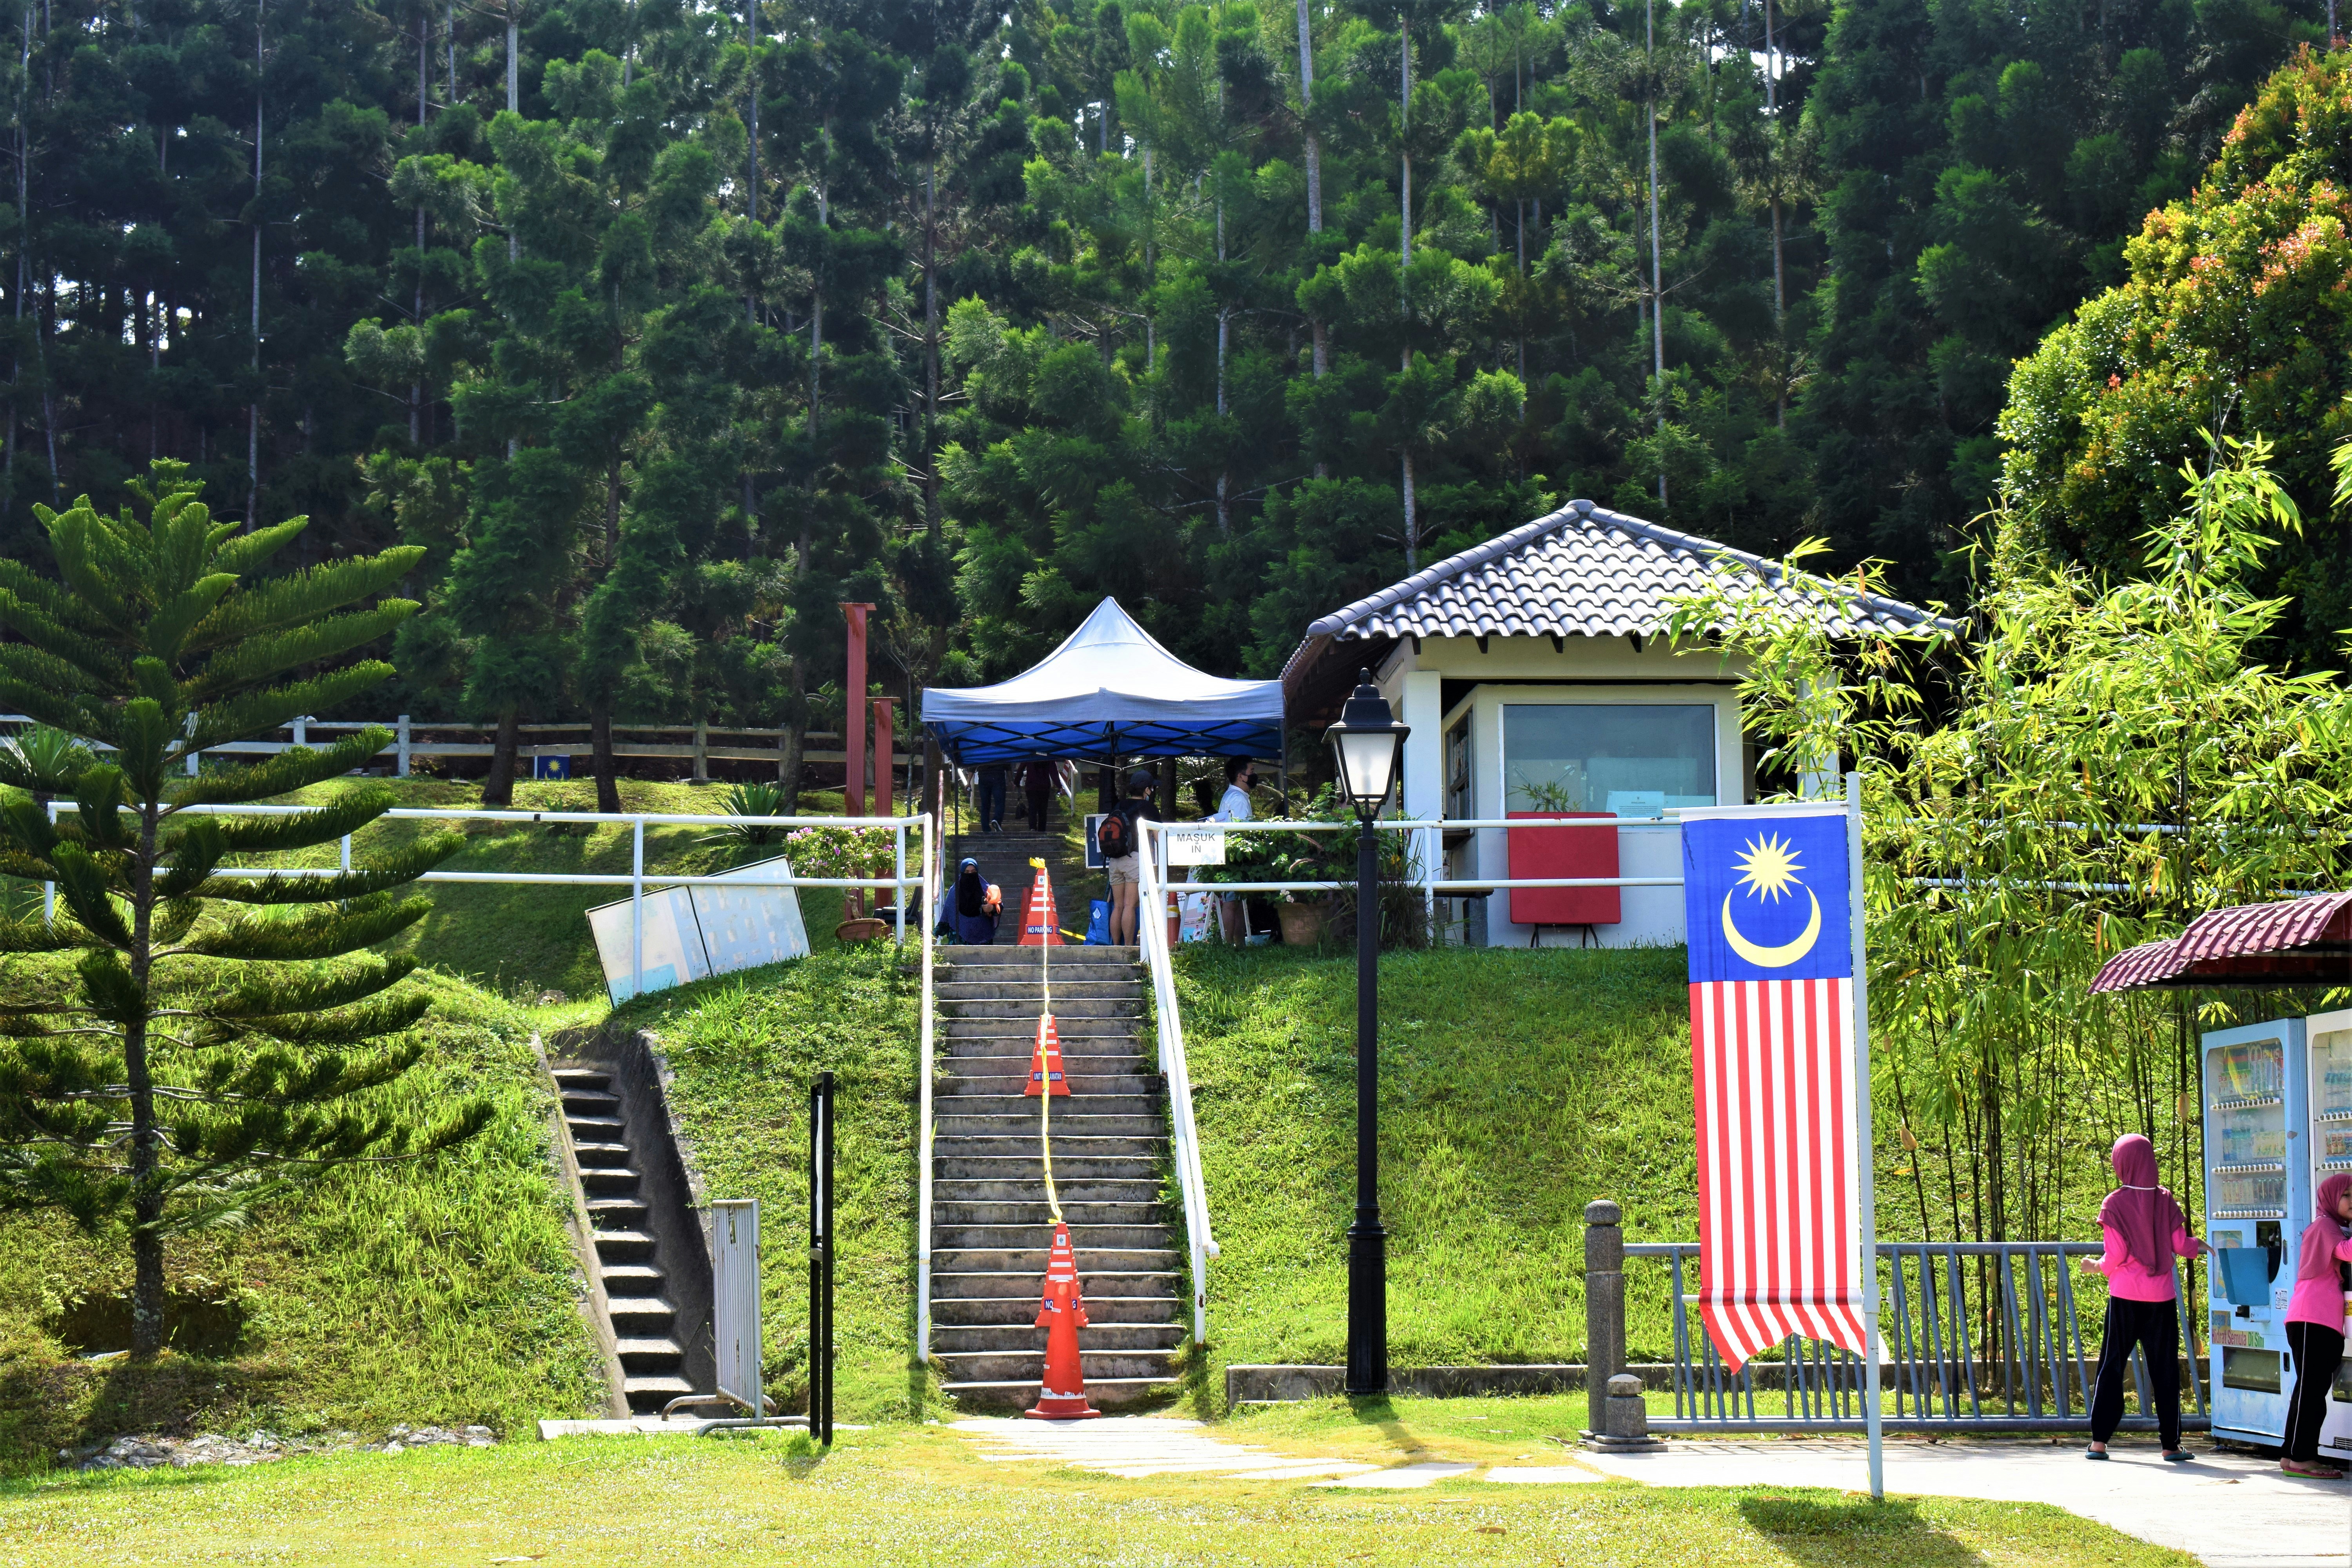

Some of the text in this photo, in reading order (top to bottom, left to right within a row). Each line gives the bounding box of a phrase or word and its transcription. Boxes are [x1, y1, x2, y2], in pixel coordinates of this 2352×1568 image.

[1177, 833, 1215, 842] MASUK
[1045, 1300, 1053, 1308] NO
[2212, 1328, 2264, 1348] Hidrat Semula Di Sini
